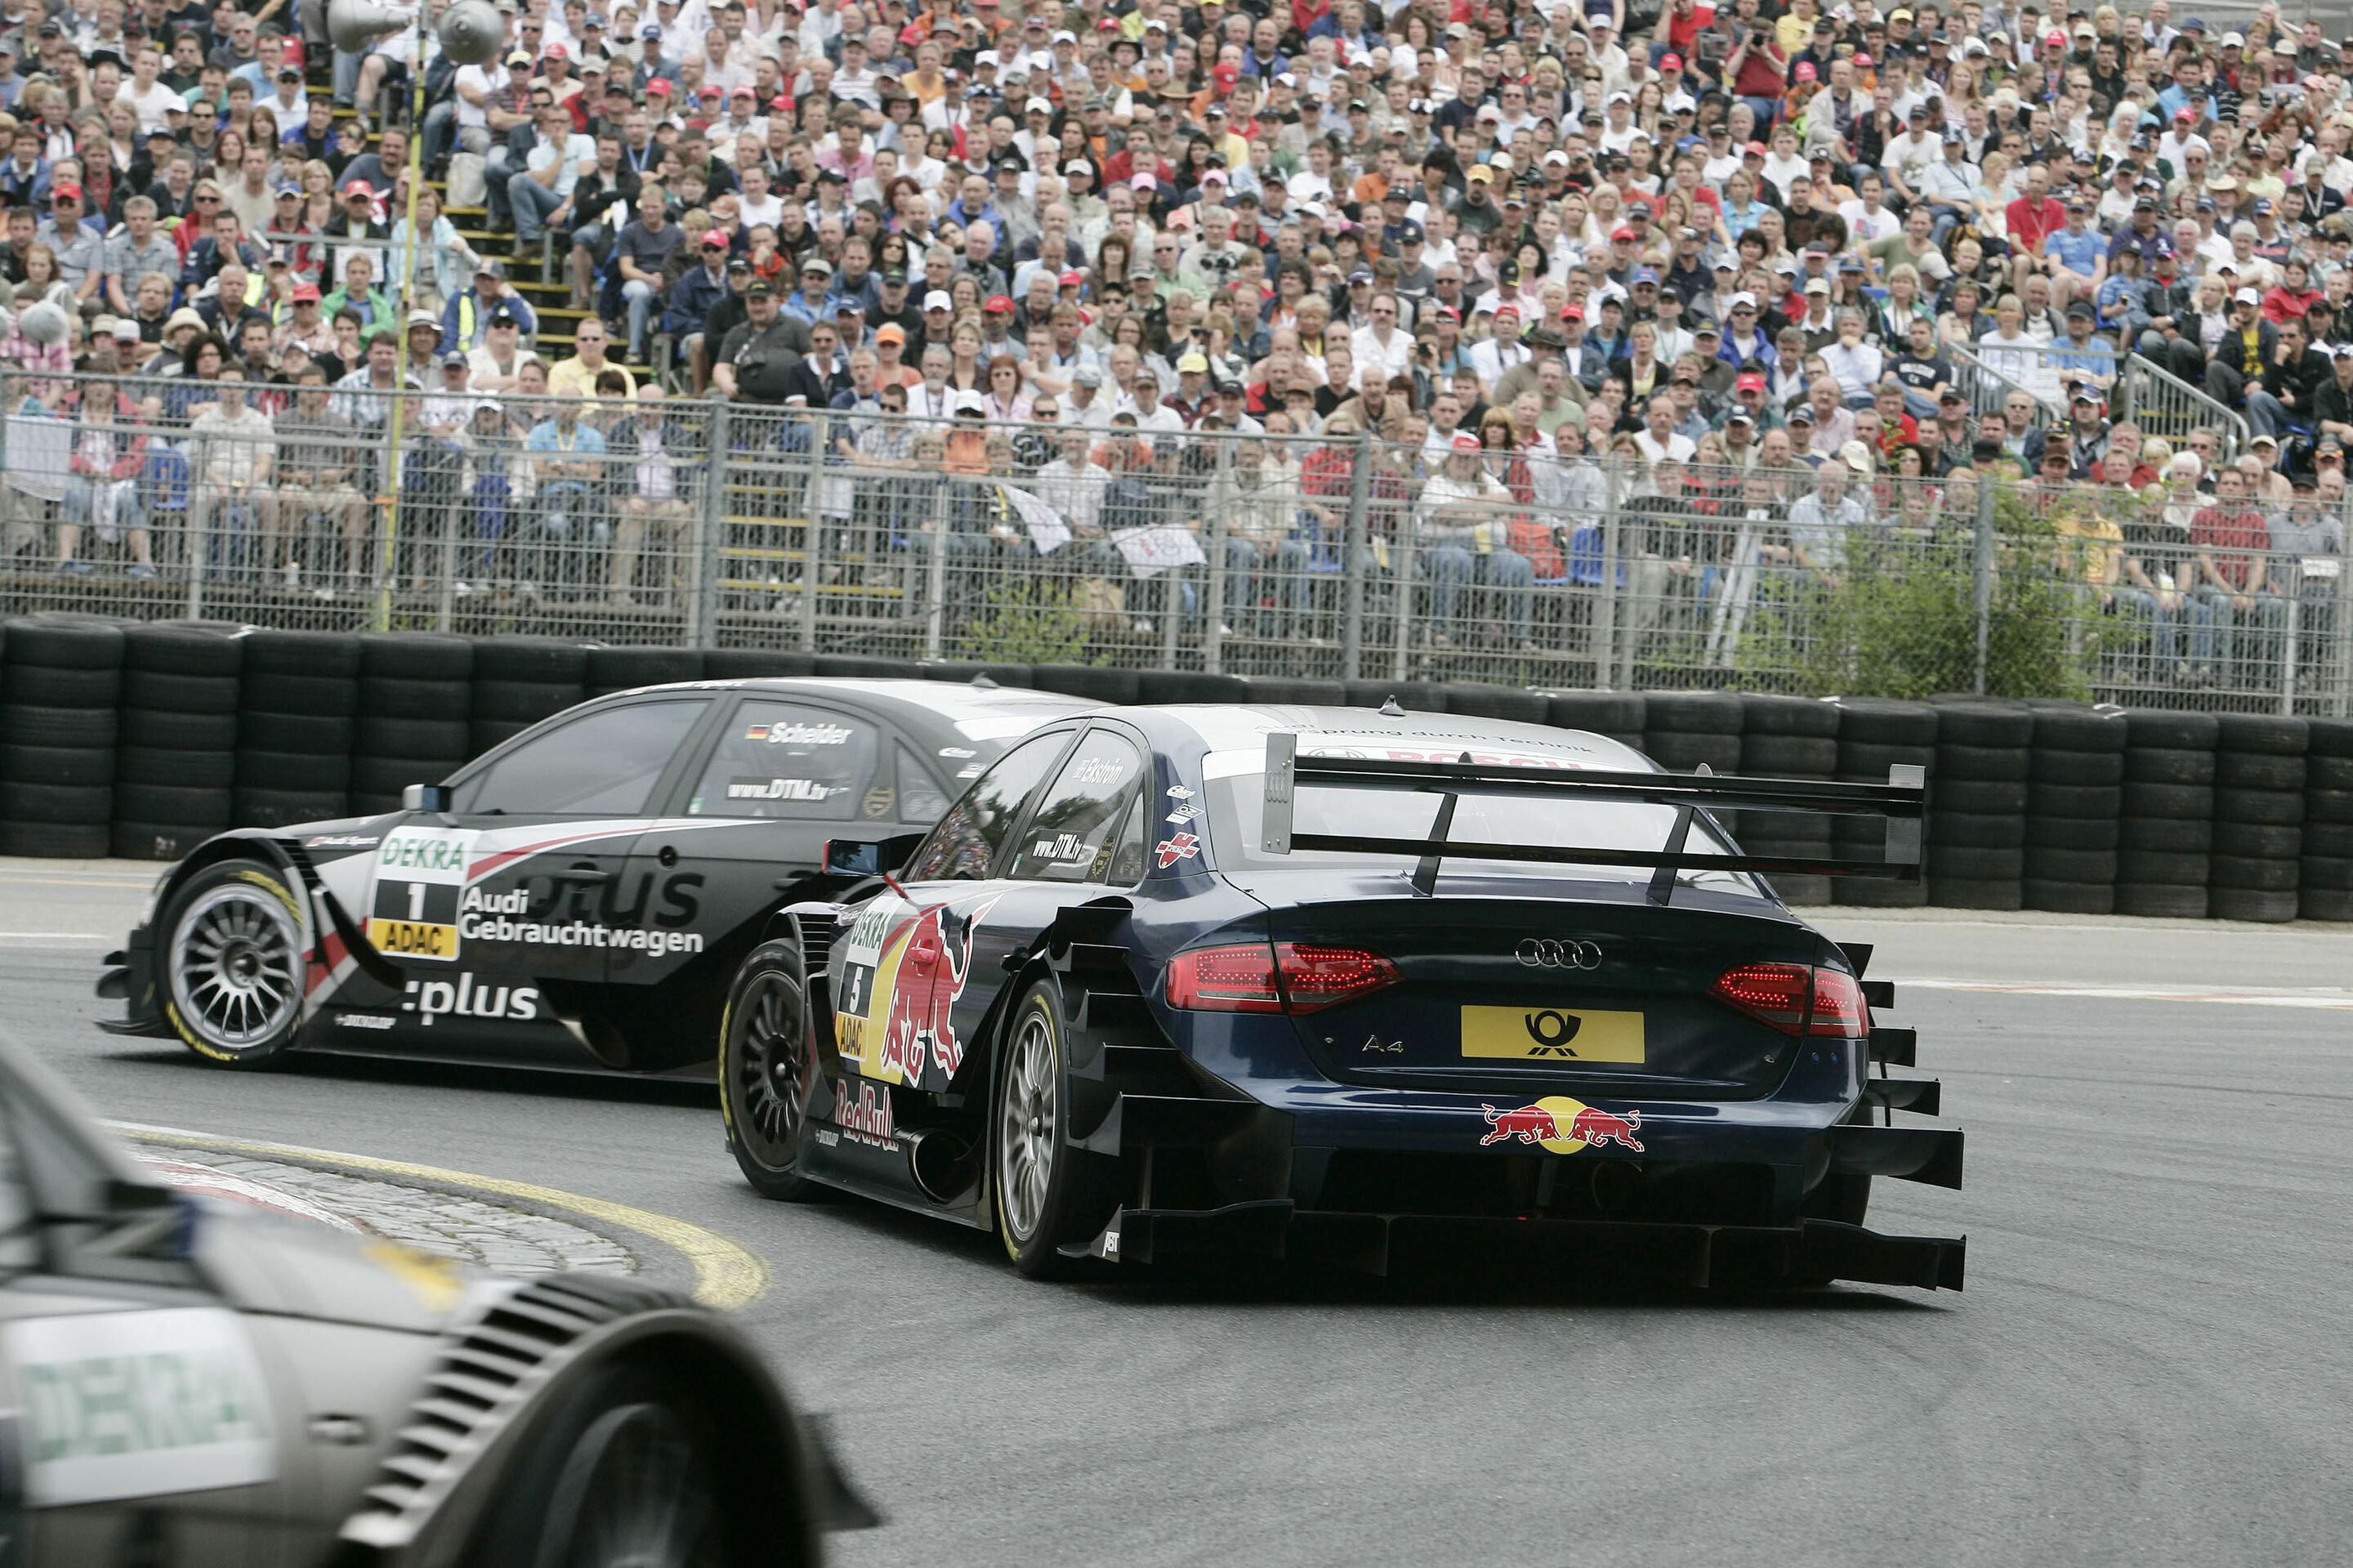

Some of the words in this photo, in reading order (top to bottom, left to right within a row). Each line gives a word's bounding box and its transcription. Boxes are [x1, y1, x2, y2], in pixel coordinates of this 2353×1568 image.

[768, 722, 854, 744] Scheider
[1412, 730, 1488, 739] durch
[1498, 737, 1596, 753] Technik
[383, 838, 464, 872] DEKRA
[1033, 833, 1083, 860] www.DTM.tv
[408, 883, 426, 920] 1
[461, 886, 529, 914] Audi
[385, 923, 443, 955] ADAC
[458, 913, 703, 957] Gebrauchtwagen
[851, 909, 890, 949] DEKRA
[849, 967, 864, 1013] 5
[840, 1016, 863, 1057] ADAC
